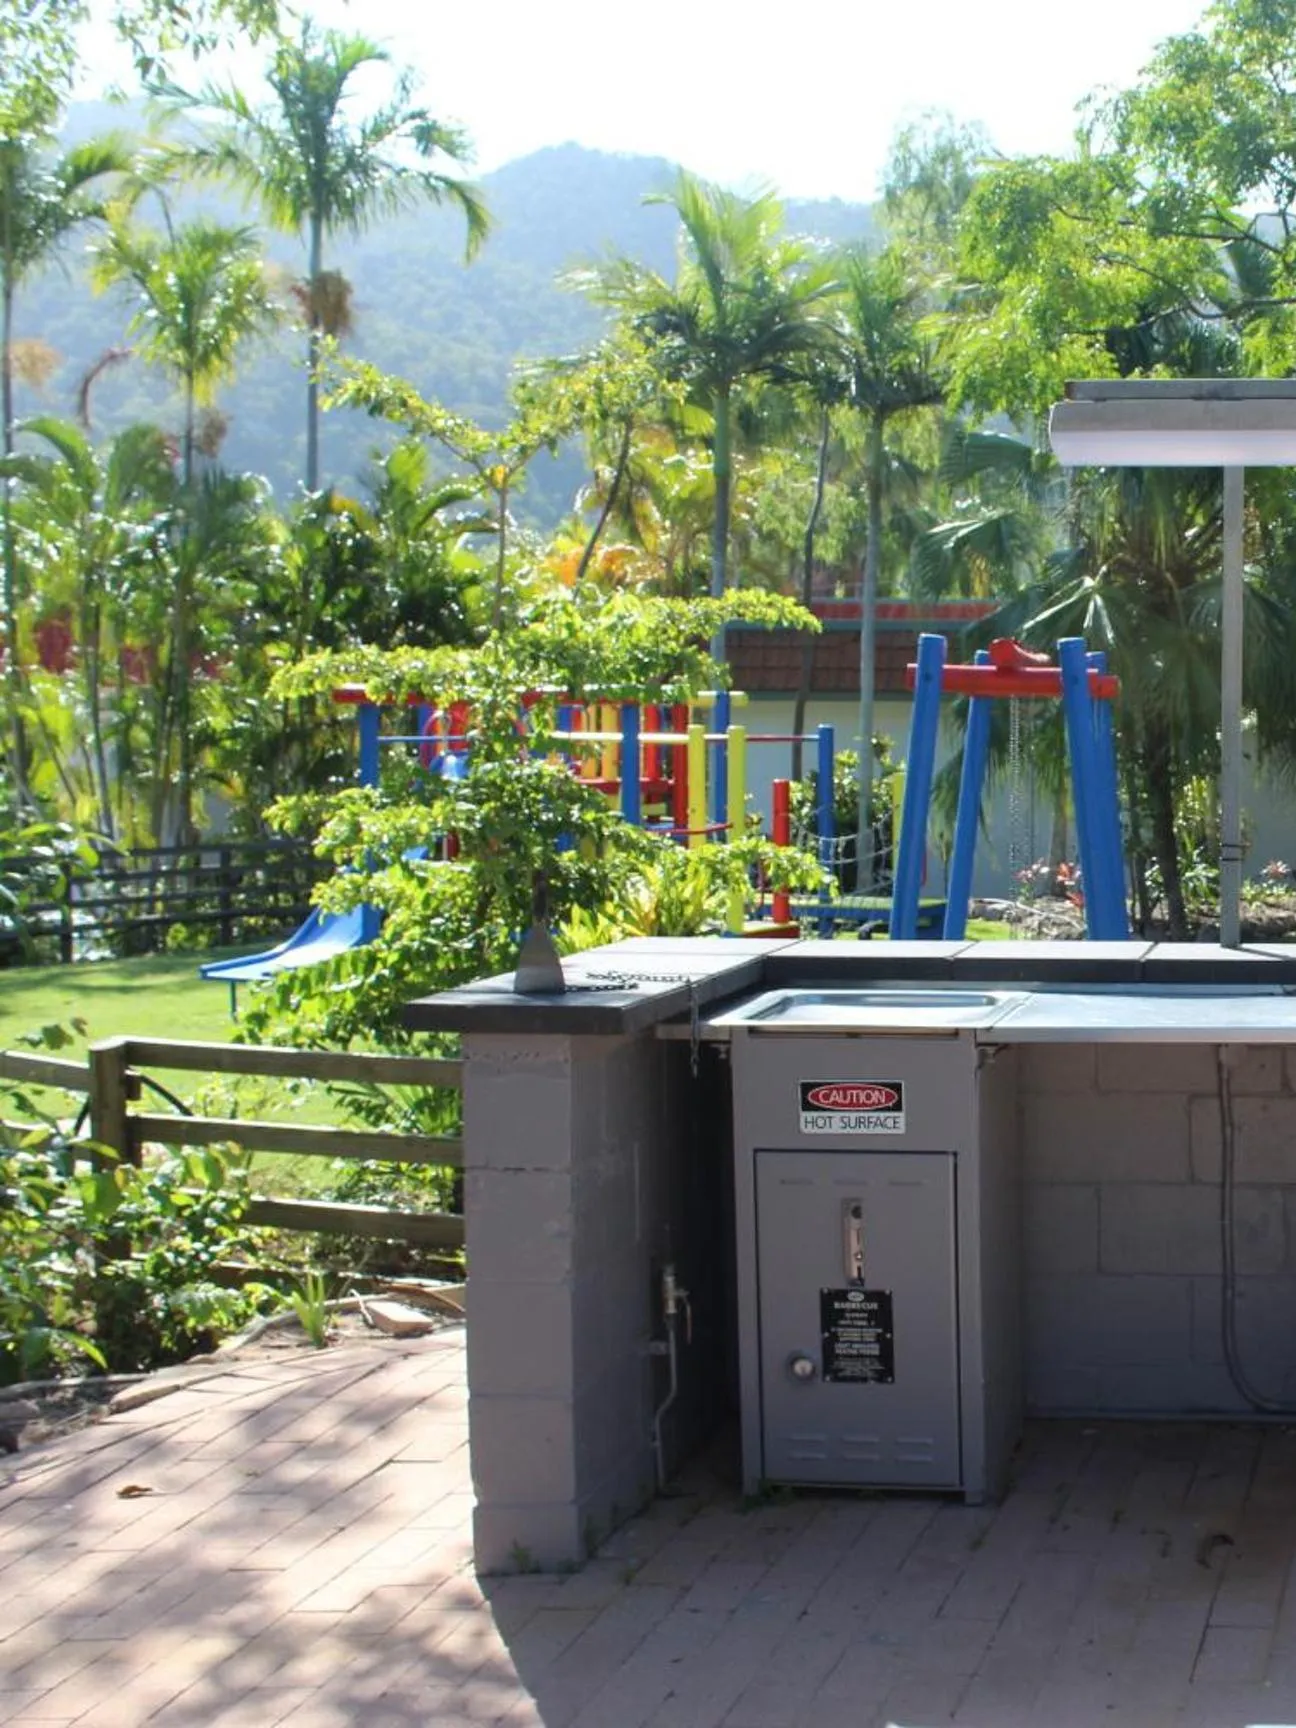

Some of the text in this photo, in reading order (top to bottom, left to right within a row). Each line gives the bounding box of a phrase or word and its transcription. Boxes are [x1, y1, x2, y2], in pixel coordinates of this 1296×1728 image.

[819, 1090, 886, 1104] CAUTION
[804, 1116, 900, 1129] HOT SURFACE
[833, 1302, 879, 1310] BARBECUE
